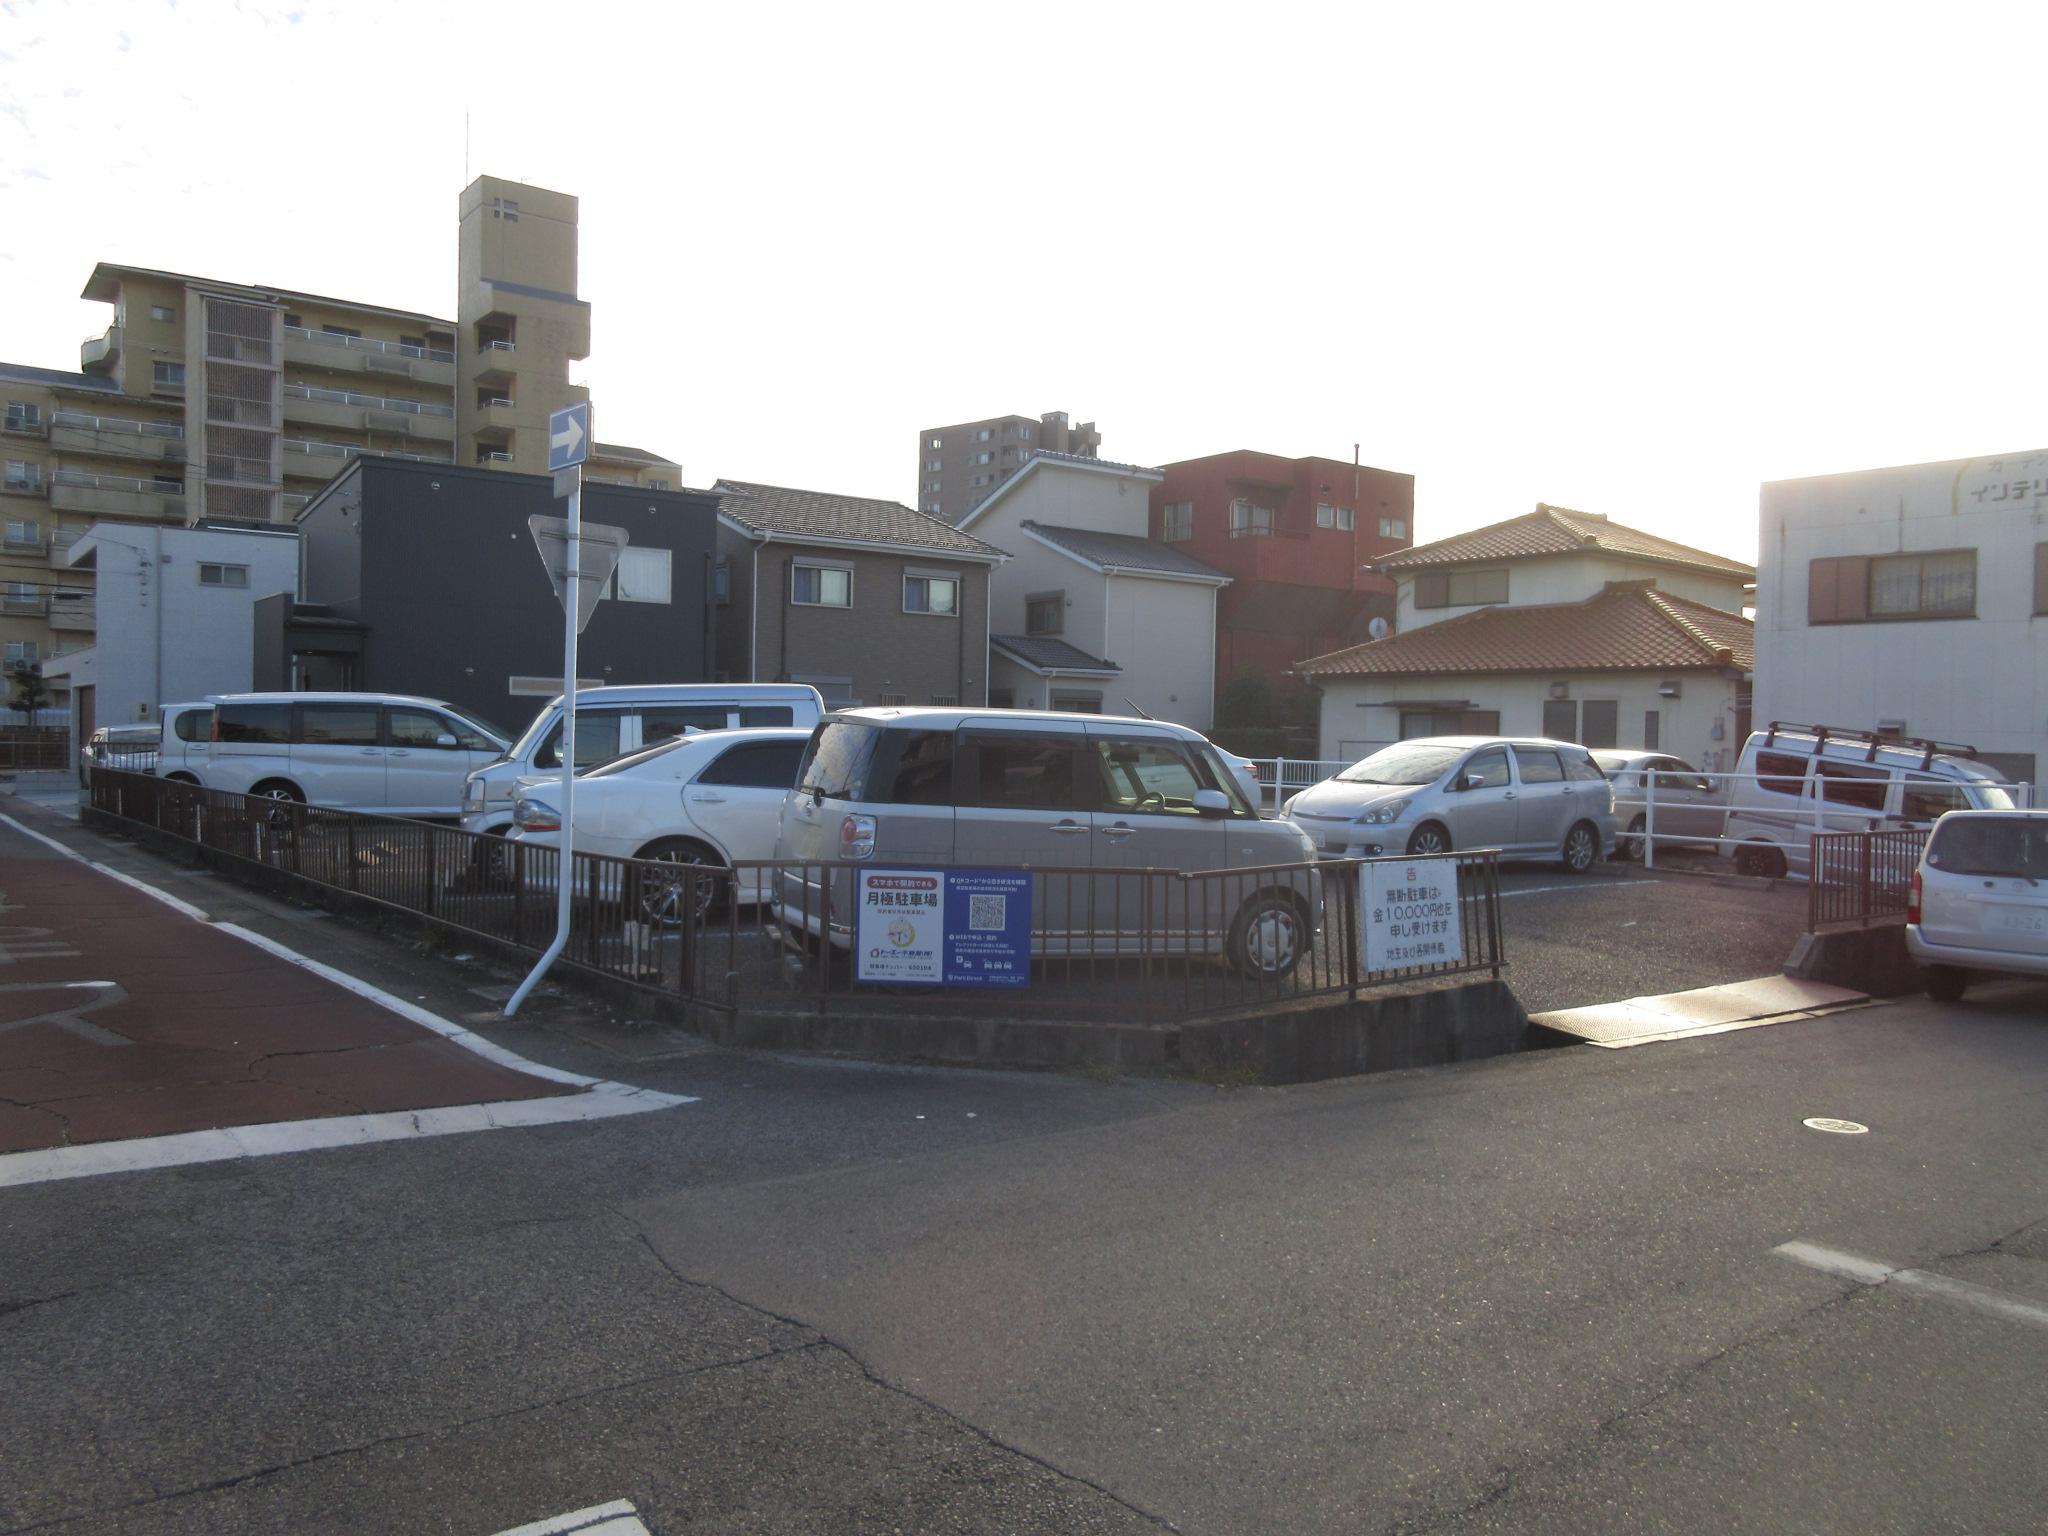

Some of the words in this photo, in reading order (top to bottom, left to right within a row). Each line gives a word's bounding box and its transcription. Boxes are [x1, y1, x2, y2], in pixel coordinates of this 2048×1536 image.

[871, 878, 933, 889] スマホで契約できる
[867, 891, 938, 907] 月極駐車場
[1390, 919, 1449, 938] 申し受けます
